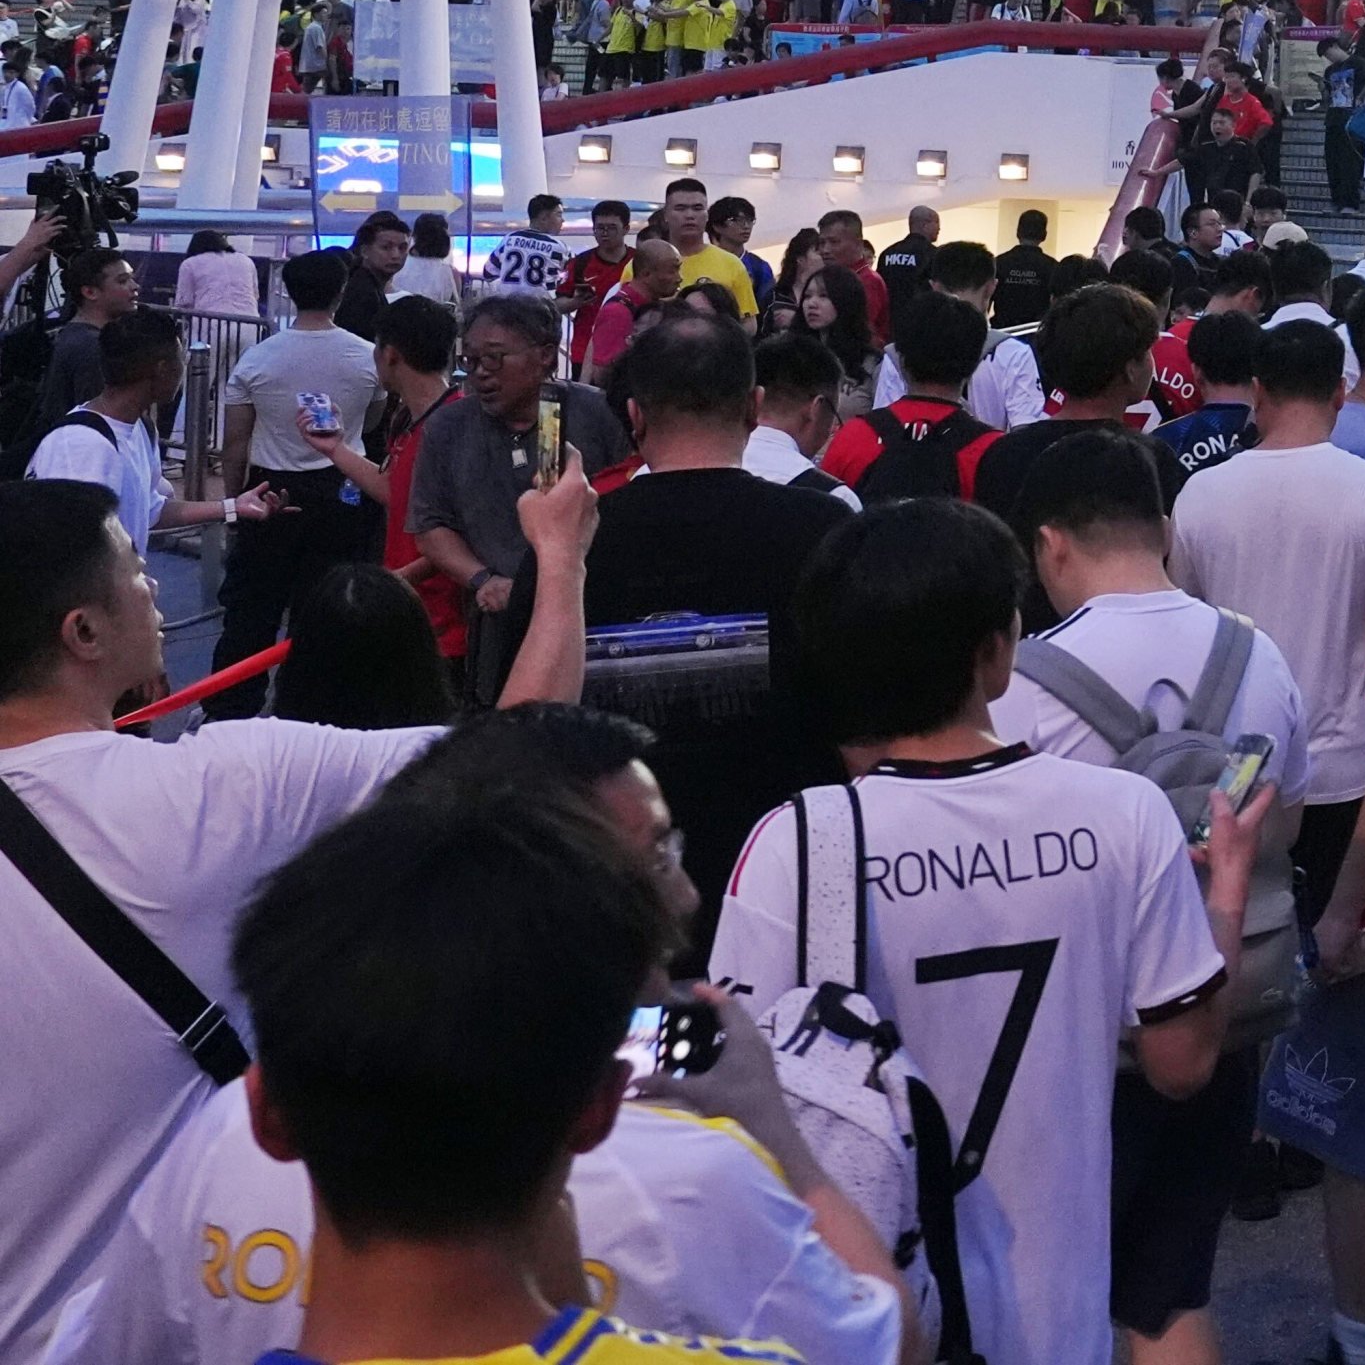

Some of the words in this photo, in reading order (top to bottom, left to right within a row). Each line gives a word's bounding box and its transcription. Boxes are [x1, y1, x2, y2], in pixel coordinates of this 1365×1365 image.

[514, 237, 553, 253] RONALDO
[885, 253, 917, 267] HKFA
[502, 250, 546, 286] 28
[866, 827, 1099, 905] RONALDO
[915, 937, 1060, 1196] 7
[1266, 1089, 1337, 1136] adidas
